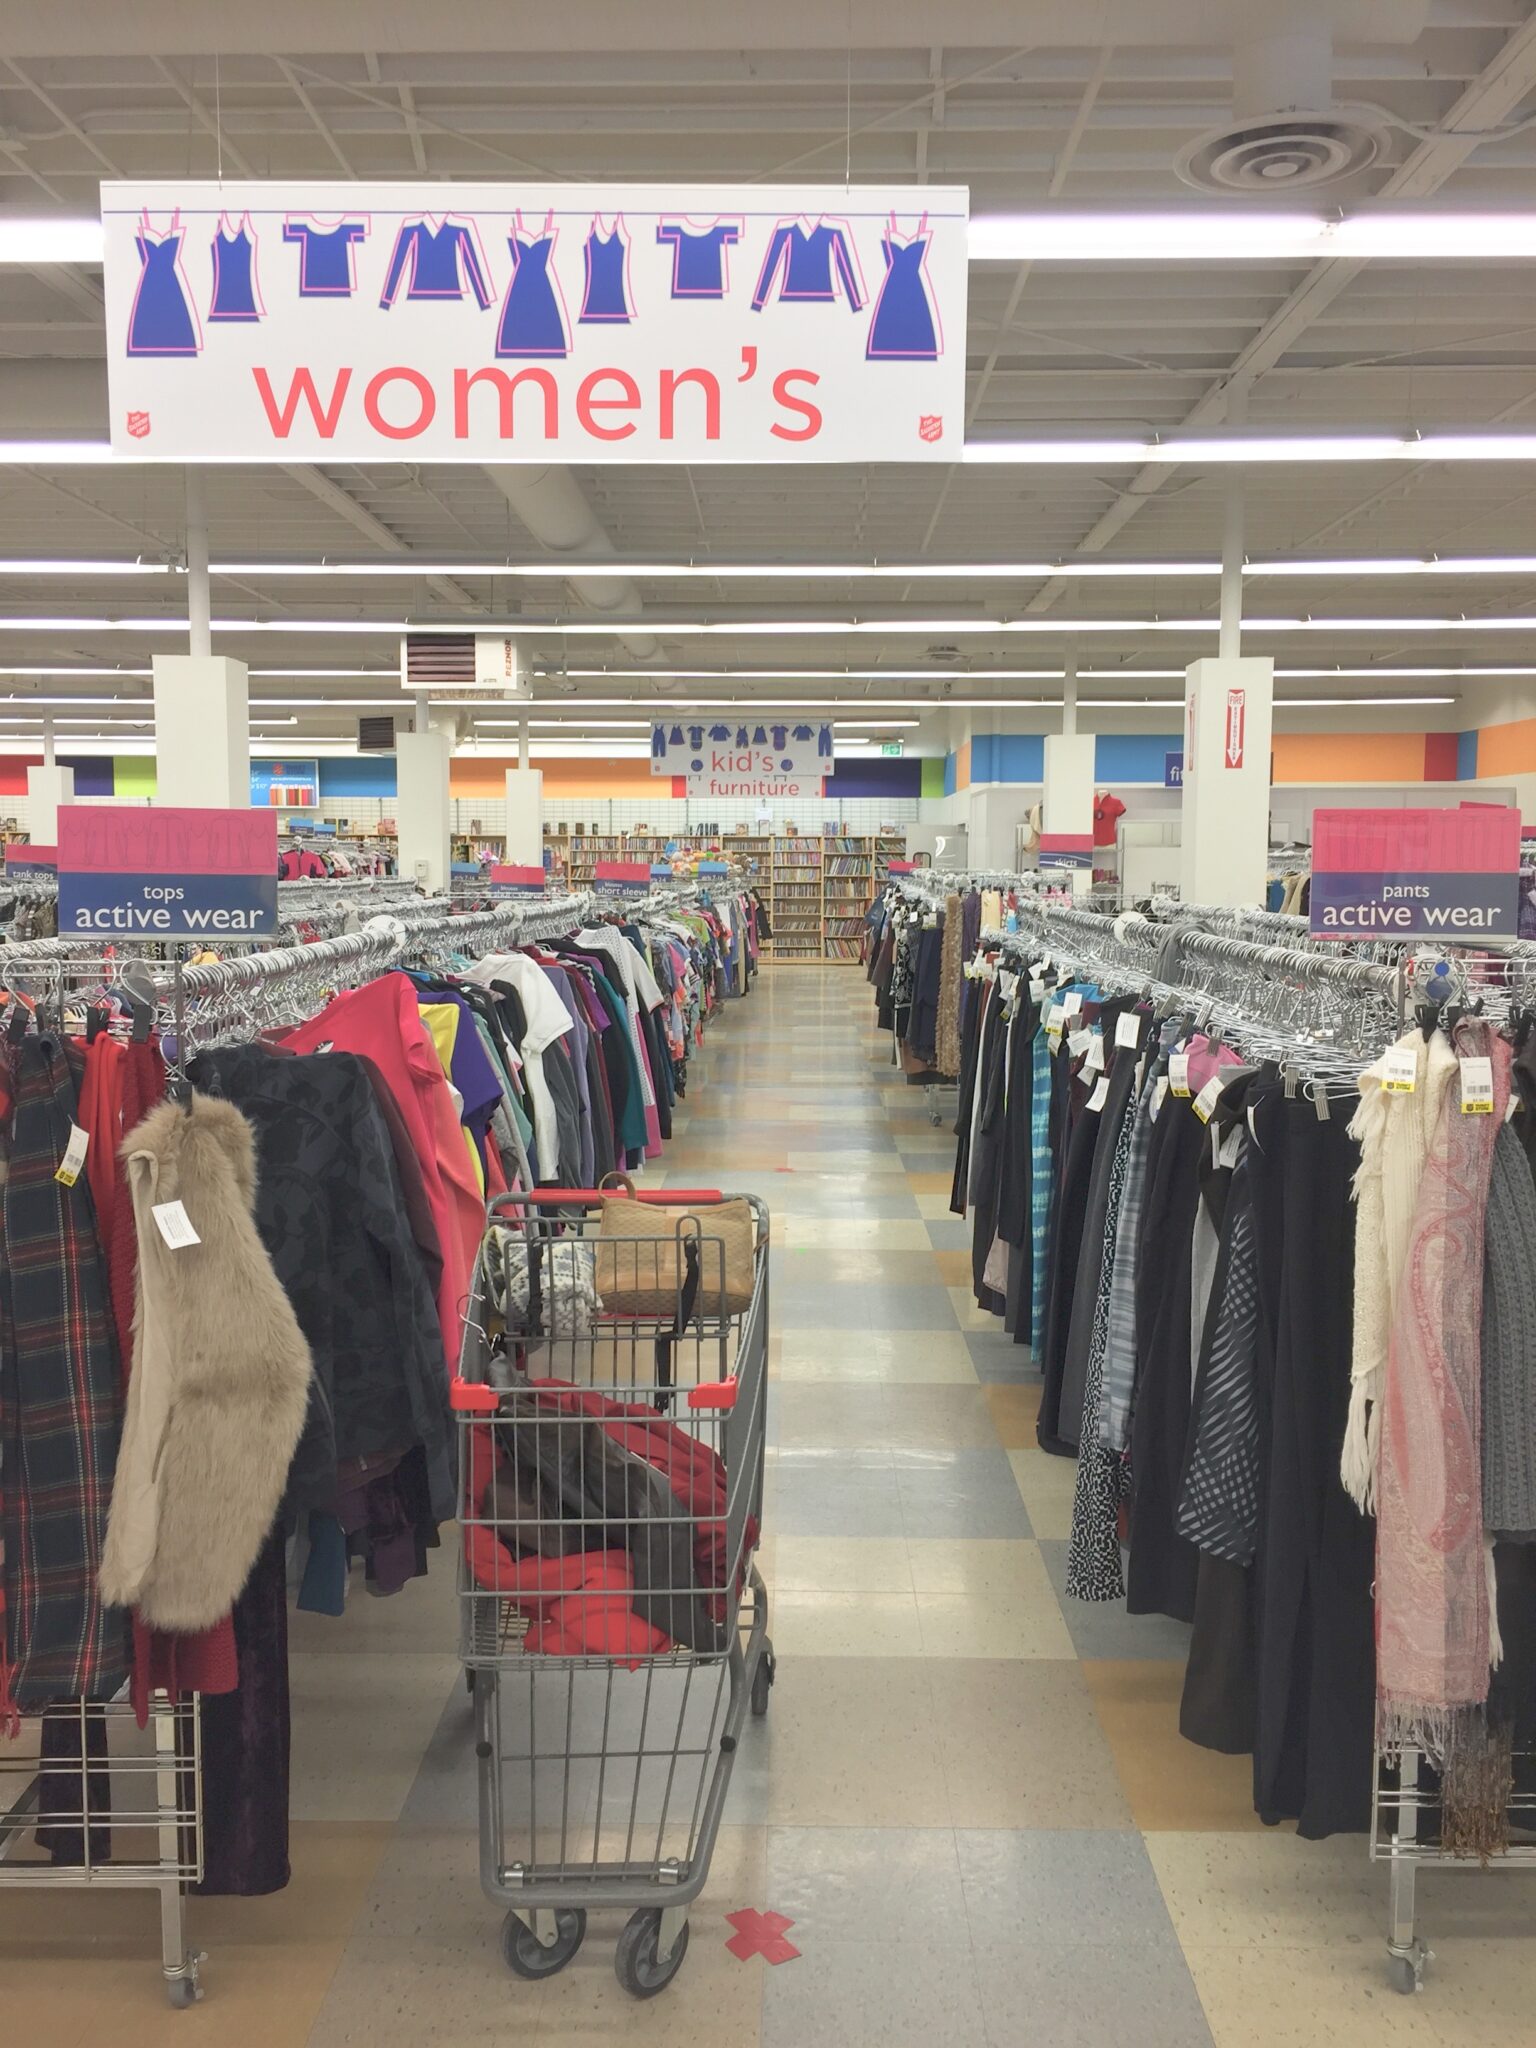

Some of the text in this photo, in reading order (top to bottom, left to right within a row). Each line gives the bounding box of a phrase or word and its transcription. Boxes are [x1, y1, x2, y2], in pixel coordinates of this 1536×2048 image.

[251, 345, 824, 441] women's
[1229, 695, 1242, 705] FIRE
[711, 751, 774, 772] kid's
[709, 780, 800, 797] furniture
[12, 870, 54, 880] tank tops
[143, 886, 184, 904] tops
[598, 886, 648, 896] short sleeve
[1383, 885, 1430, 902] pants
[76, 902, 264, 928] active wear
[1323, 900, 1502, 926] active wear
